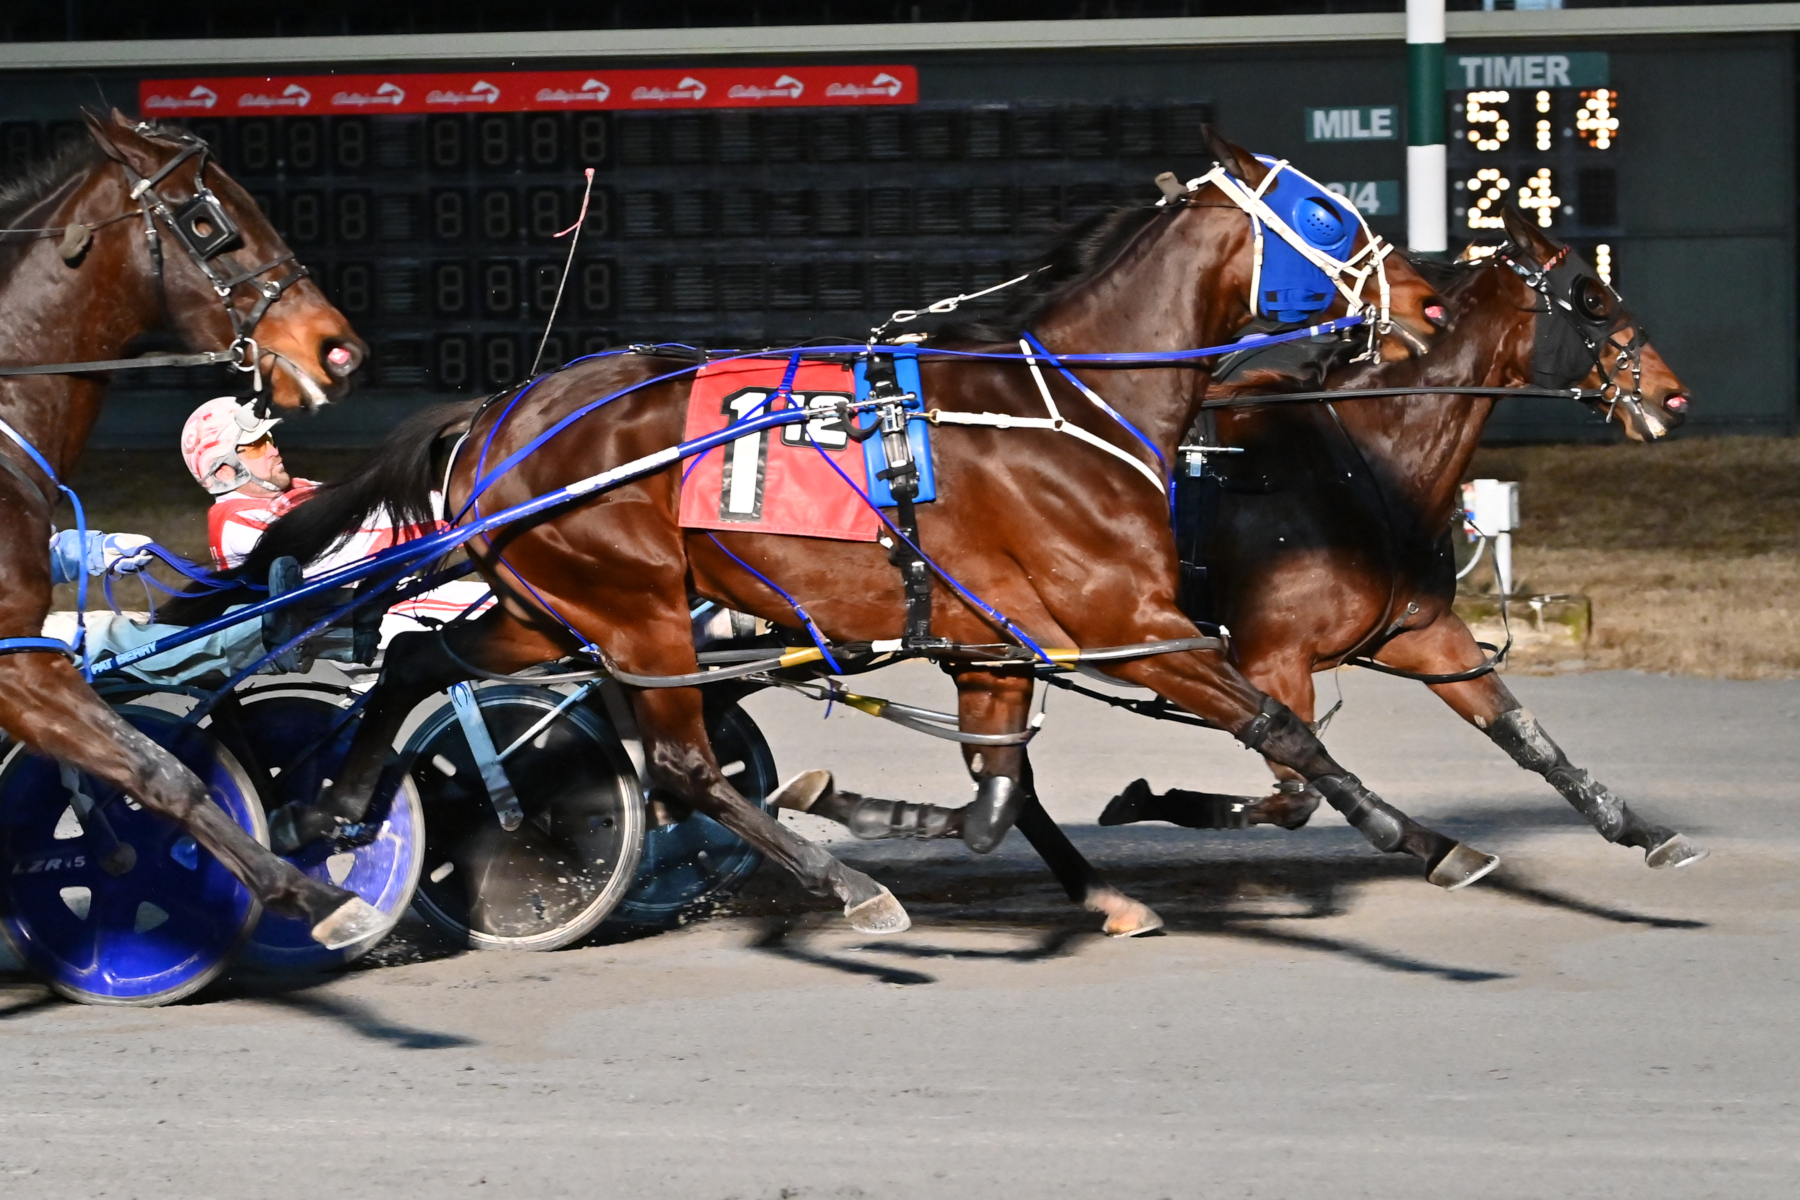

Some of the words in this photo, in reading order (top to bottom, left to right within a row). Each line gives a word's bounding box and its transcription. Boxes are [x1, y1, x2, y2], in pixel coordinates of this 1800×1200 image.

[1459, 54, 1572, 87] TIMER
[1312, 107, 1393, 139] MILE
[724, 389, 770, 517] 1
[115, 641, 157, 666] BERRY
